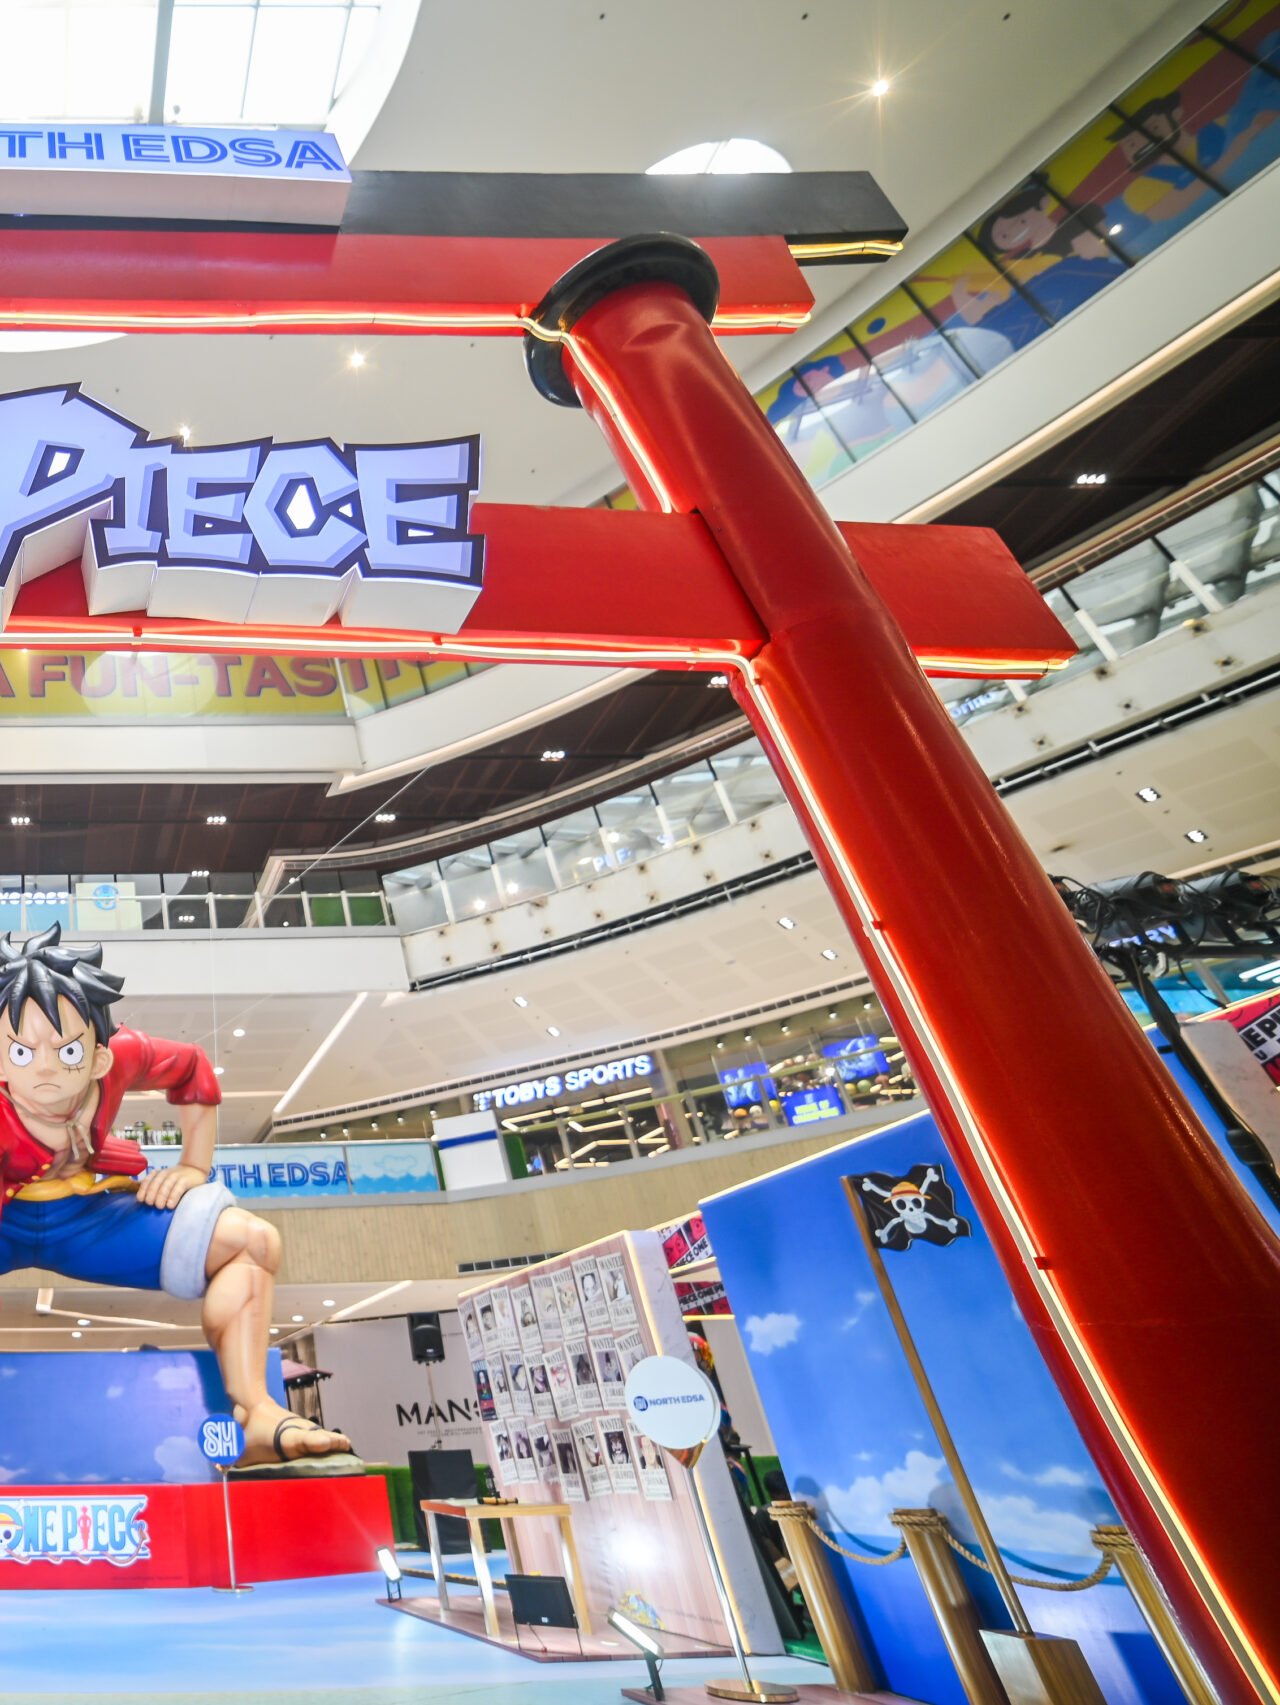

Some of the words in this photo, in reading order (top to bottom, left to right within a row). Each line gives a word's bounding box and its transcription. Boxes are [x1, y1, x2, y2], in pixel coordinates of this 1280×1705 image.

[122, 133, 345, 171] EDSA
[565, 1055, 653, 1091] SPORTS
[269, 1161, 352, 1188] EDSA
[649, 1396, 680, 1406] NORTH
[681, 1394, 705, 1404] EDSA
[202, 1421, 238, 1457] SM
[61, 1502, 147, 1553] PIECE
